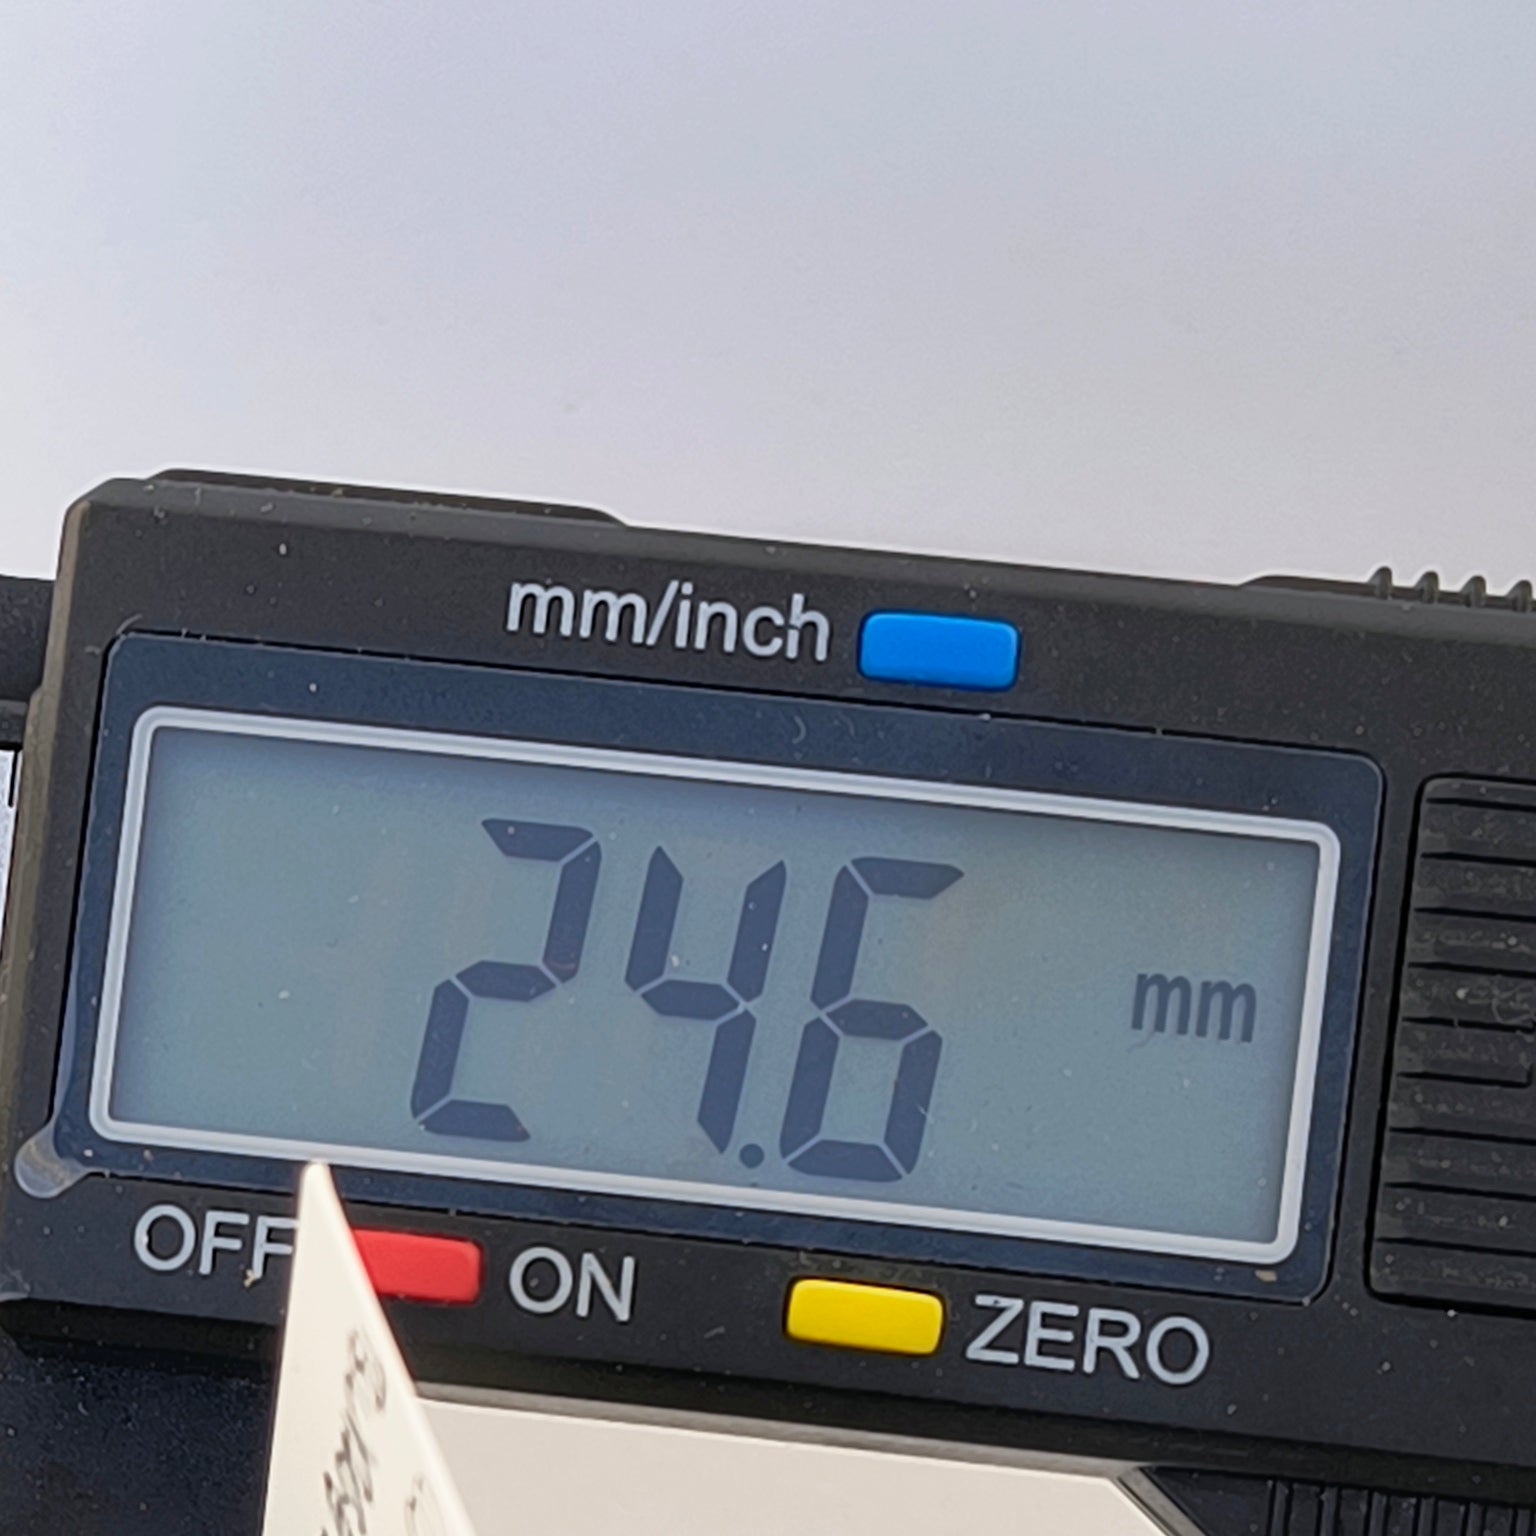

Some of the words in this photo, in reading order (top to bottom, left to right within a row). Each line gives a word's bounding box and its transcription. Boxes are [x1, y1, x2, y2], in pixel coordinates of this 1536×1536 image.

[506, 580, 832, 664] mm/inch
[409, 817, 965, 1185] 24.6
[1131, 967, 1258, 1043] mm
[133, 1204, 298, 1281] OFF
[507, 1247, 637, 1323] ON
[966, 1294, 1210, 1387] ZERO
